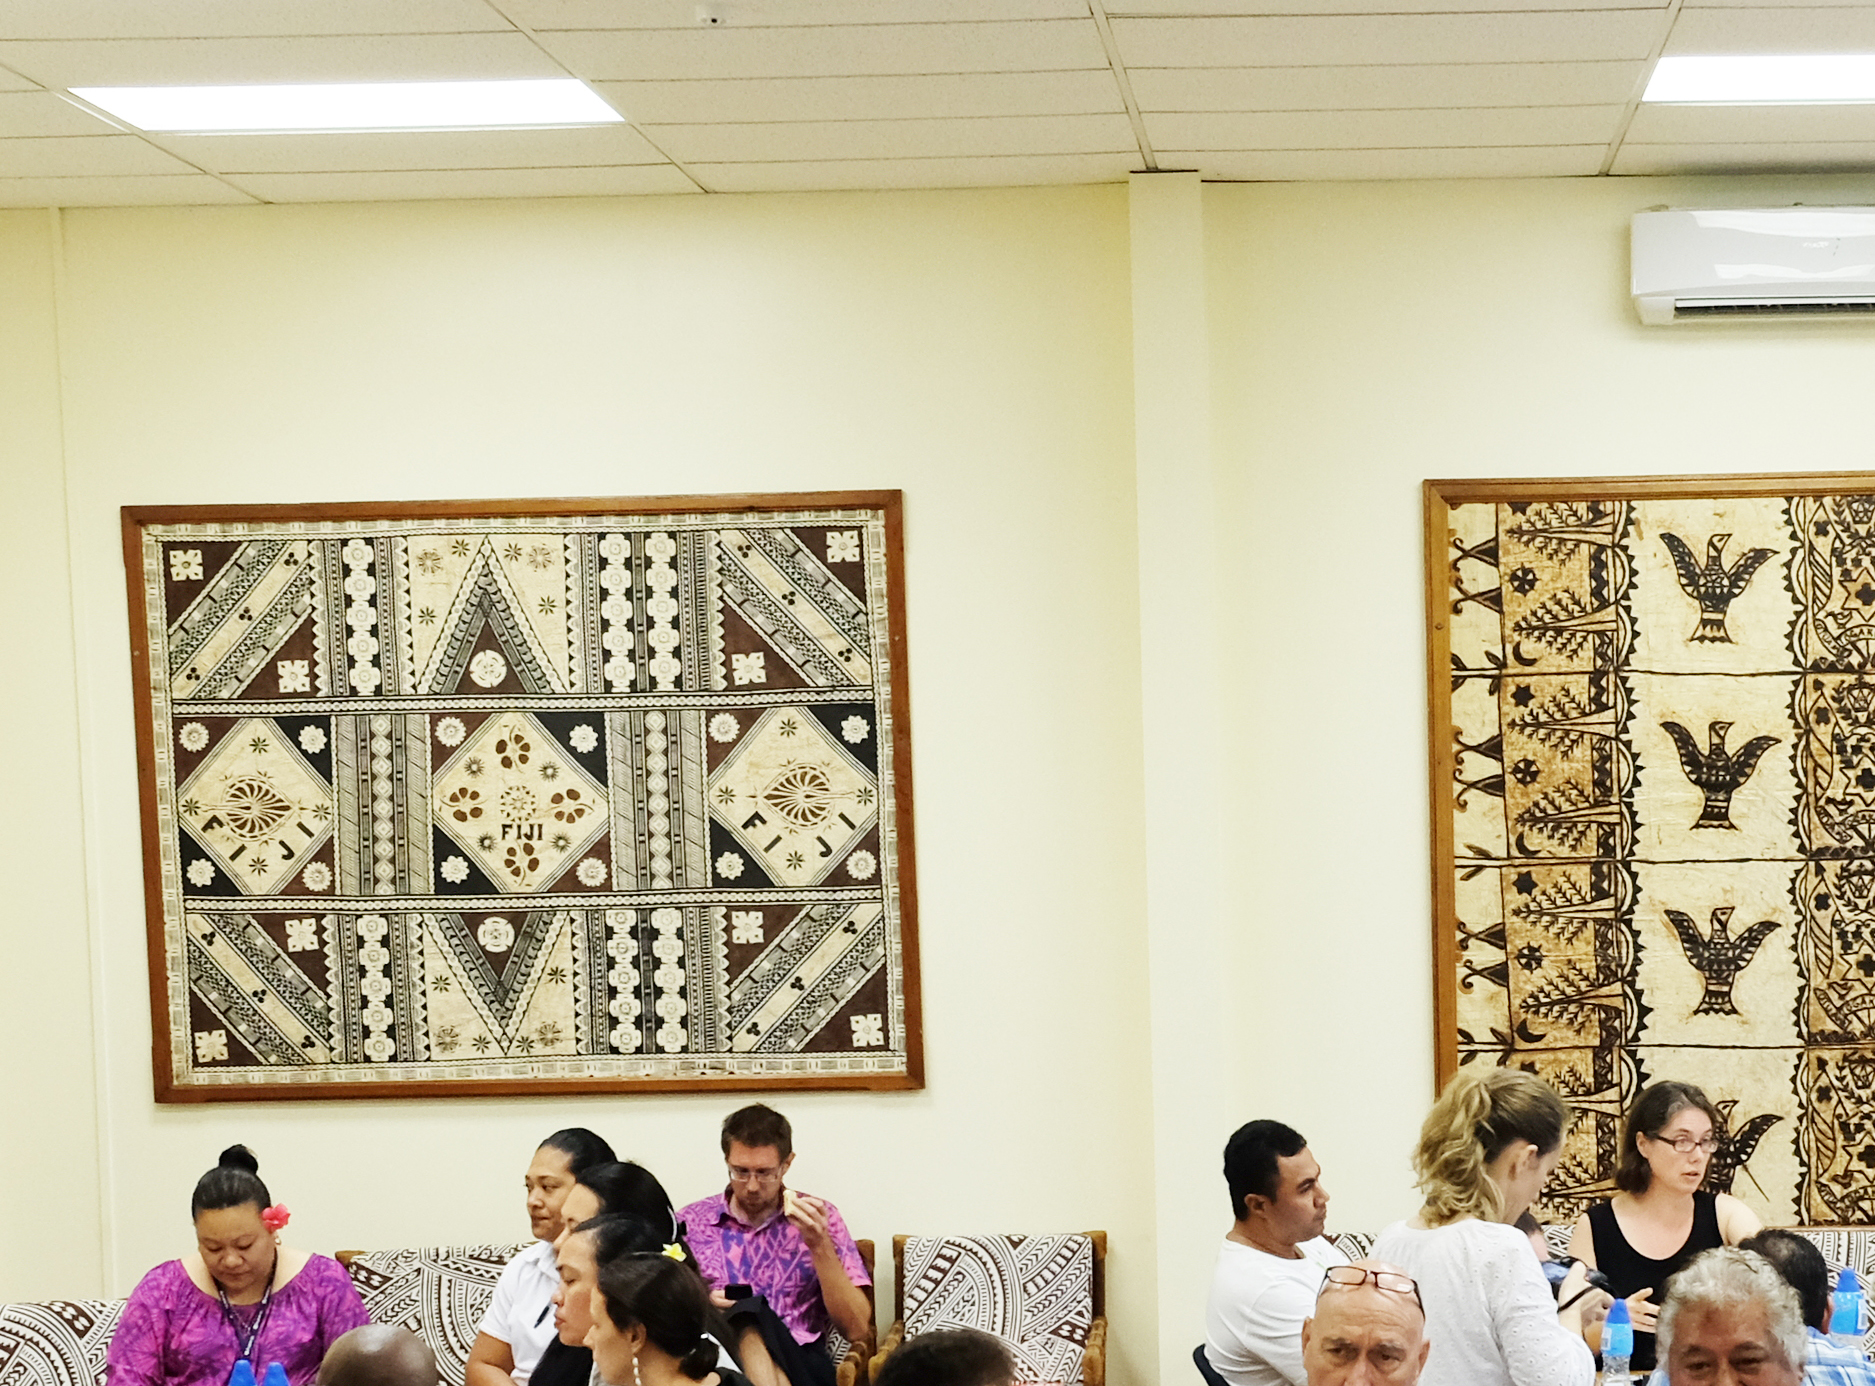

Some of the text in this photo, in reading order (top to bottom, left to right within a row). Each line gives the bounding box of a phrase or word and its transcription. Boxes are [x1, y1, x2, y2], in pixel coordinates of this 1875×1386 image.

[201, 815, 315, 862] FIJI
[501, 823, 543, 841] FIJI
[741, 811, 856, 857] FIJI
